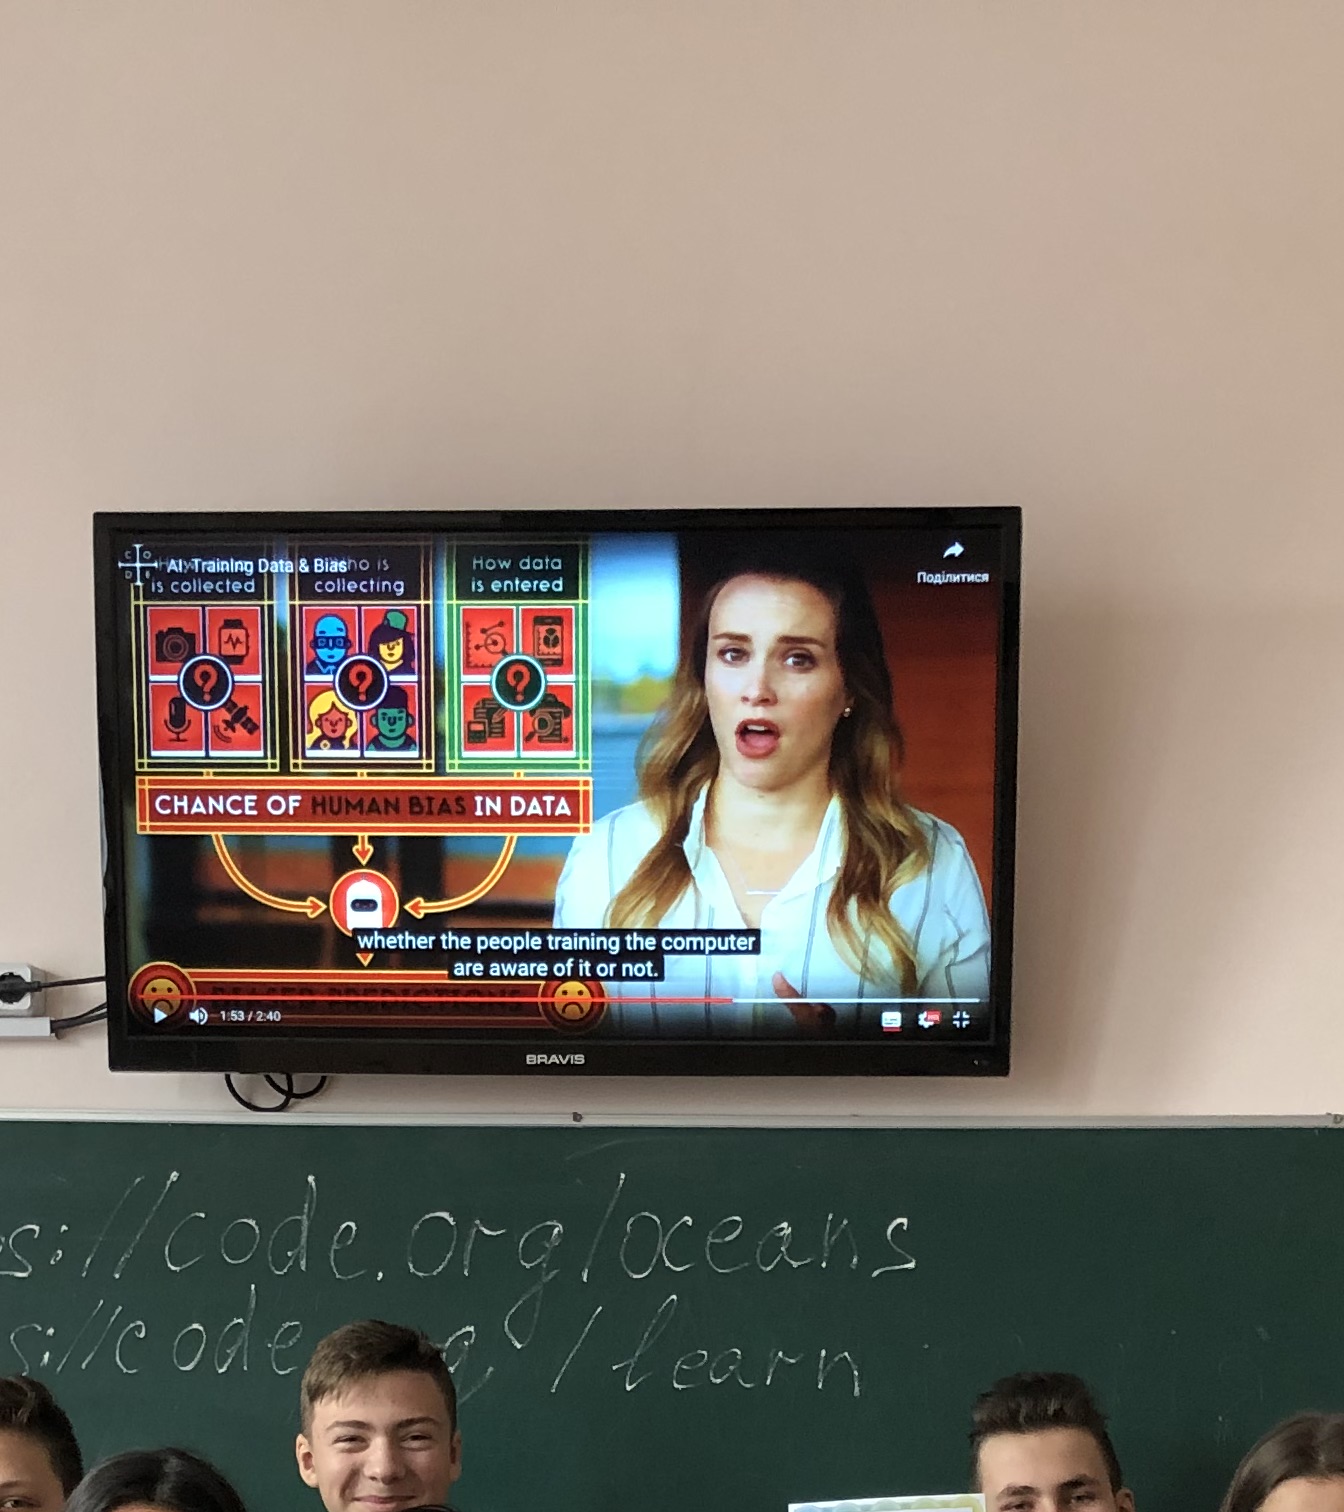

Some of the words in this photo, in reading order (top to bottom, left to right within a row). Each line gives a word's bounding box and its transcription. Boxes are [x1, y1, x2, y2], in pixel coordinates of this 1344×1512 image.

[193, 557, 254, 577] Training
[258, 558, 294, 573] Data
[298, 558, 311, 573] &
[313, 557, 348, 573] Bias
[472, 555, 512, 571] How
[518, 555, 563, 571] data
[151, 578, 164, 593] is
[169, 577, 256, 593] collected
[471, 576, 485, 593] is
[490, 576, 564, 593] entered
[916, 570, 990, 585] Поділитися
[314, 578, 406, 597] collecting
[155, 793, 258, 816] CHANCE
[265, 794, 302, 816] OF
[310, 795, 400, 816] HUMAN
[408, 795, 466, 816] BIAS
[473, 794, 503, 816] IN
[509, 795, 572, 817] DATA
[357, 931, 436, 952] whether
[440, 932, 472, 952] the
[476, 932, 543, 956] people
[547, 932, 621, 956] training
[624, 932, 656, 952] the
[661, 934, 756, 957] computer
[453, 961, 485, 976] are
[489, 961, 548, 976] aware
[552, 957, 575, 976] of
[578, 957, 591, 976] it
[596, 961, 617, 976] or
[621, 958, 659, 977] not.
[219, 1009, 246, 1022] 1:53
[255, 1009, 282, 1022] 2:40
[525, 1053, 586, 1065] BRAVIS
